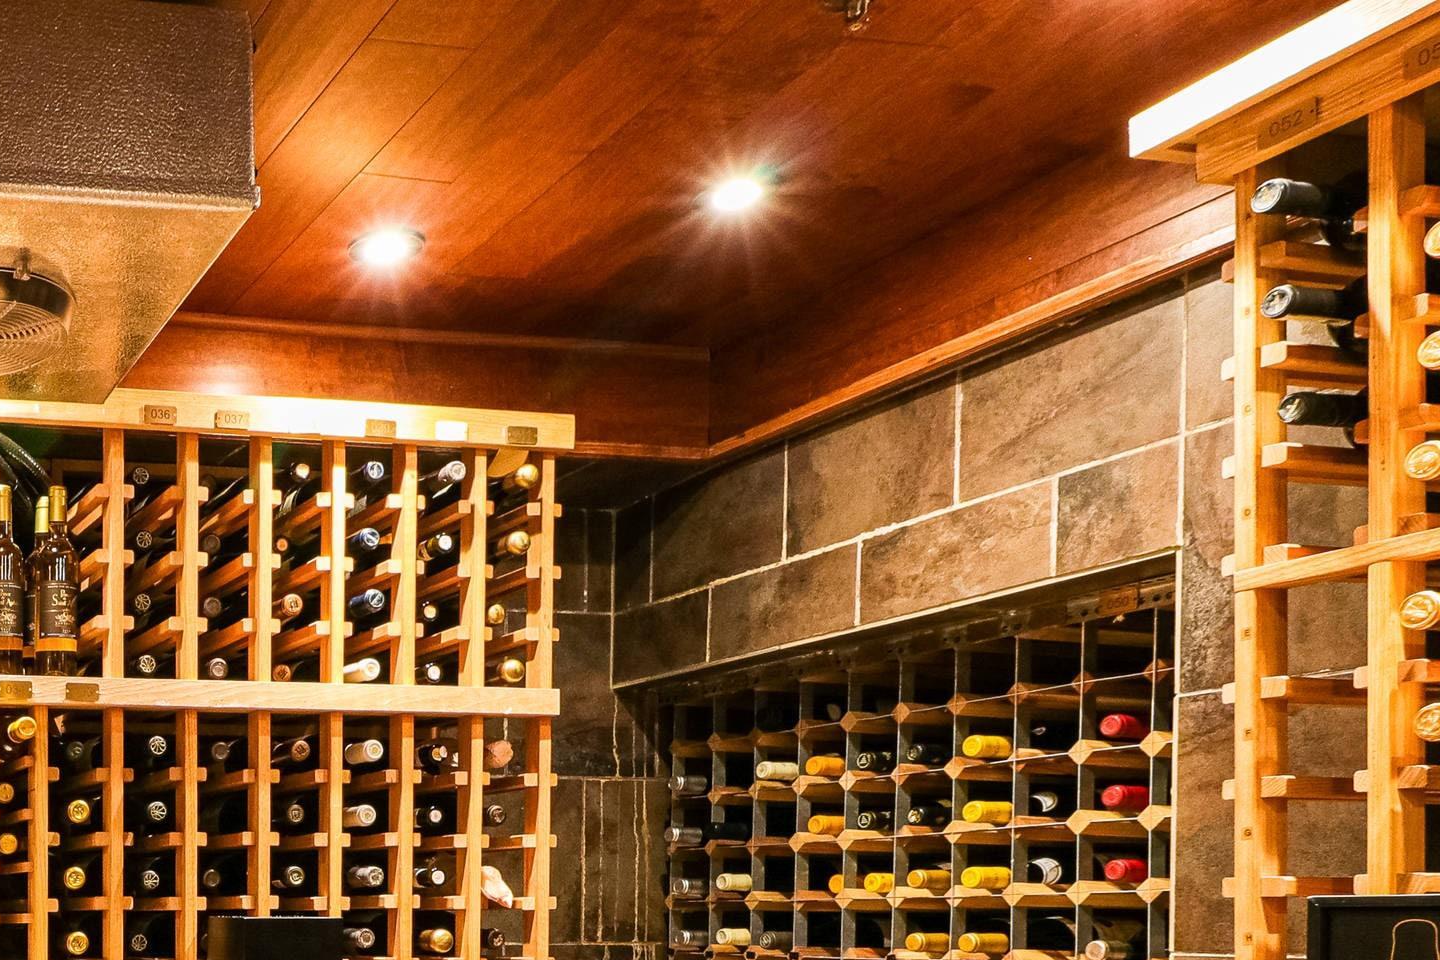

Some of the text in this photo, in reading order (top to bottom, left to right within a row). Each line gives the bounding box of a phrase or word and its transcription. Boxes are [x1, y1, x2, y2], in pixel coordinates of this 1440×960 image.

[1269, 110, 1305, 138] 052
[151, 408, 171, 420] 036
[224, 413, 244, 425] 037
